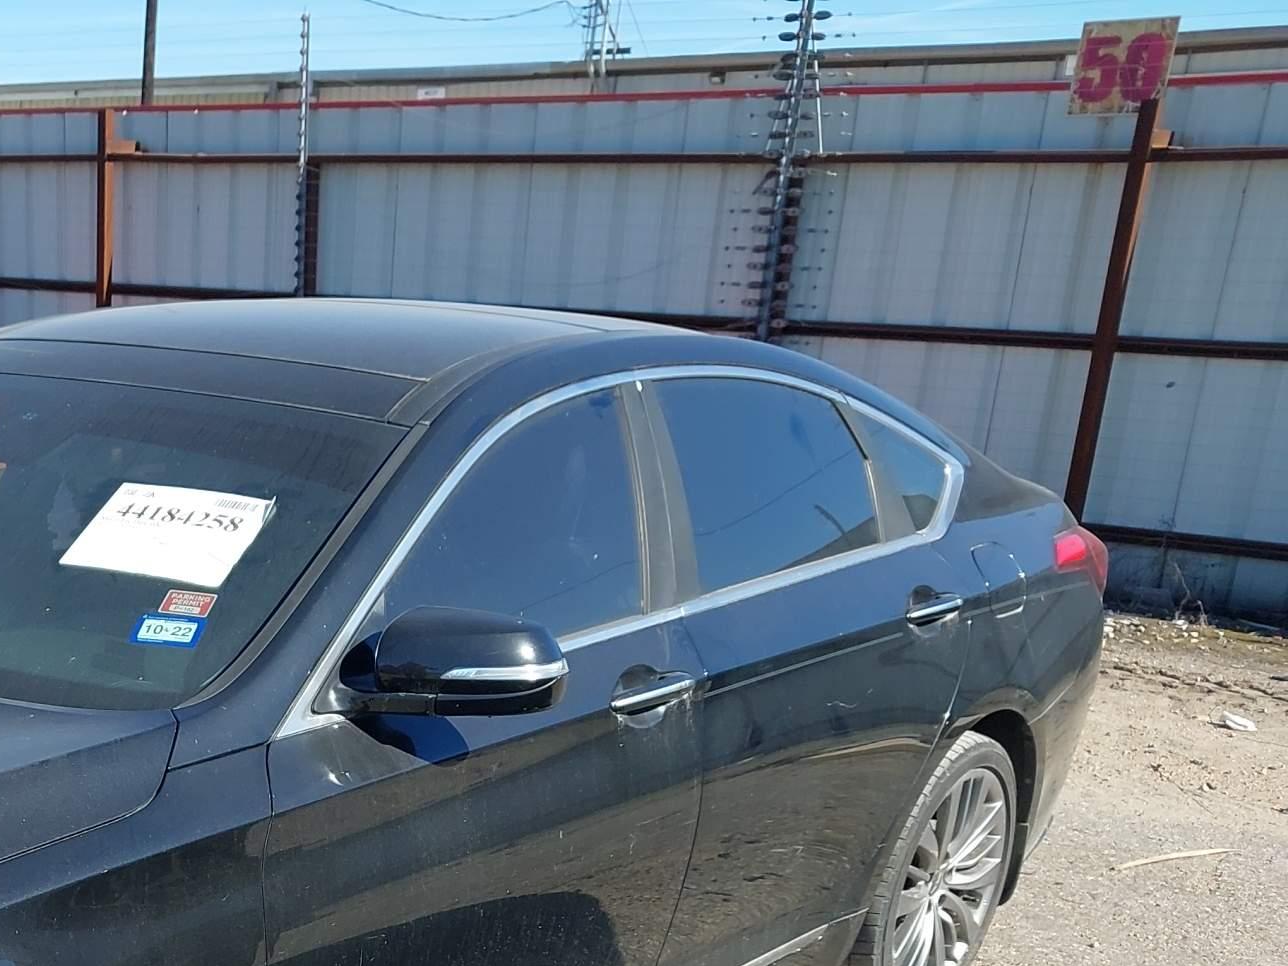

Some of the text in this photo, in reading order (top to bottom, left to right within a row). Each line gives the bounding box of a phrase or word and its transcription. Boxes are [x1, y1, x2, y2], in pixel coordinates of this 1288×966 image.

[116, 502, 244, 532] 44184258
[171, 592, 211, 602] PARKING
[171, 598, 204, 607] PERMIT
